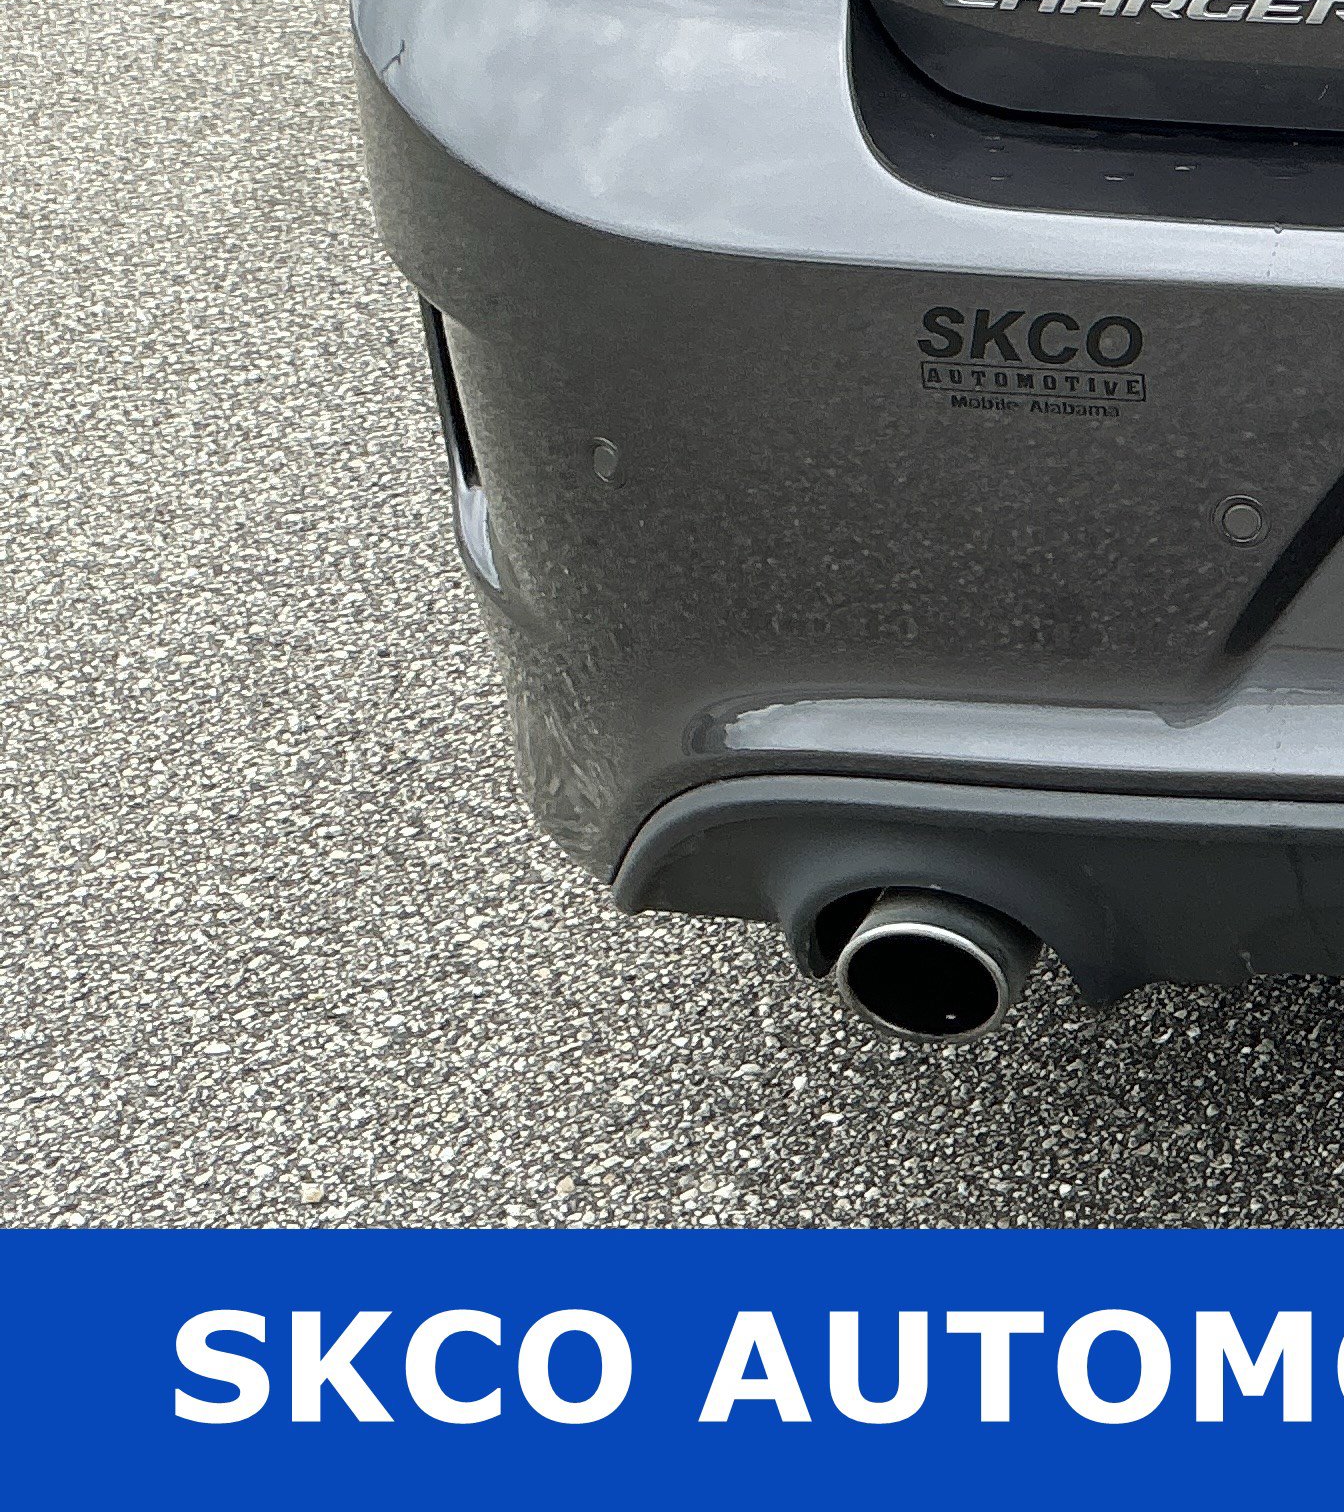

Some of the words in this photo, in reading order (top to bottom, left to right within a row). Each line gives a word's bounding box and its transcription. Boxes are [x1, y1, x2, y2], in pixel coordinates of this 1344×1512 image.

[917, 306, 1144, 368] SKCO
[926, 368, 1142, 397] AUTOMOTIVE
[1029, 399, 1121, 418] Alabama
